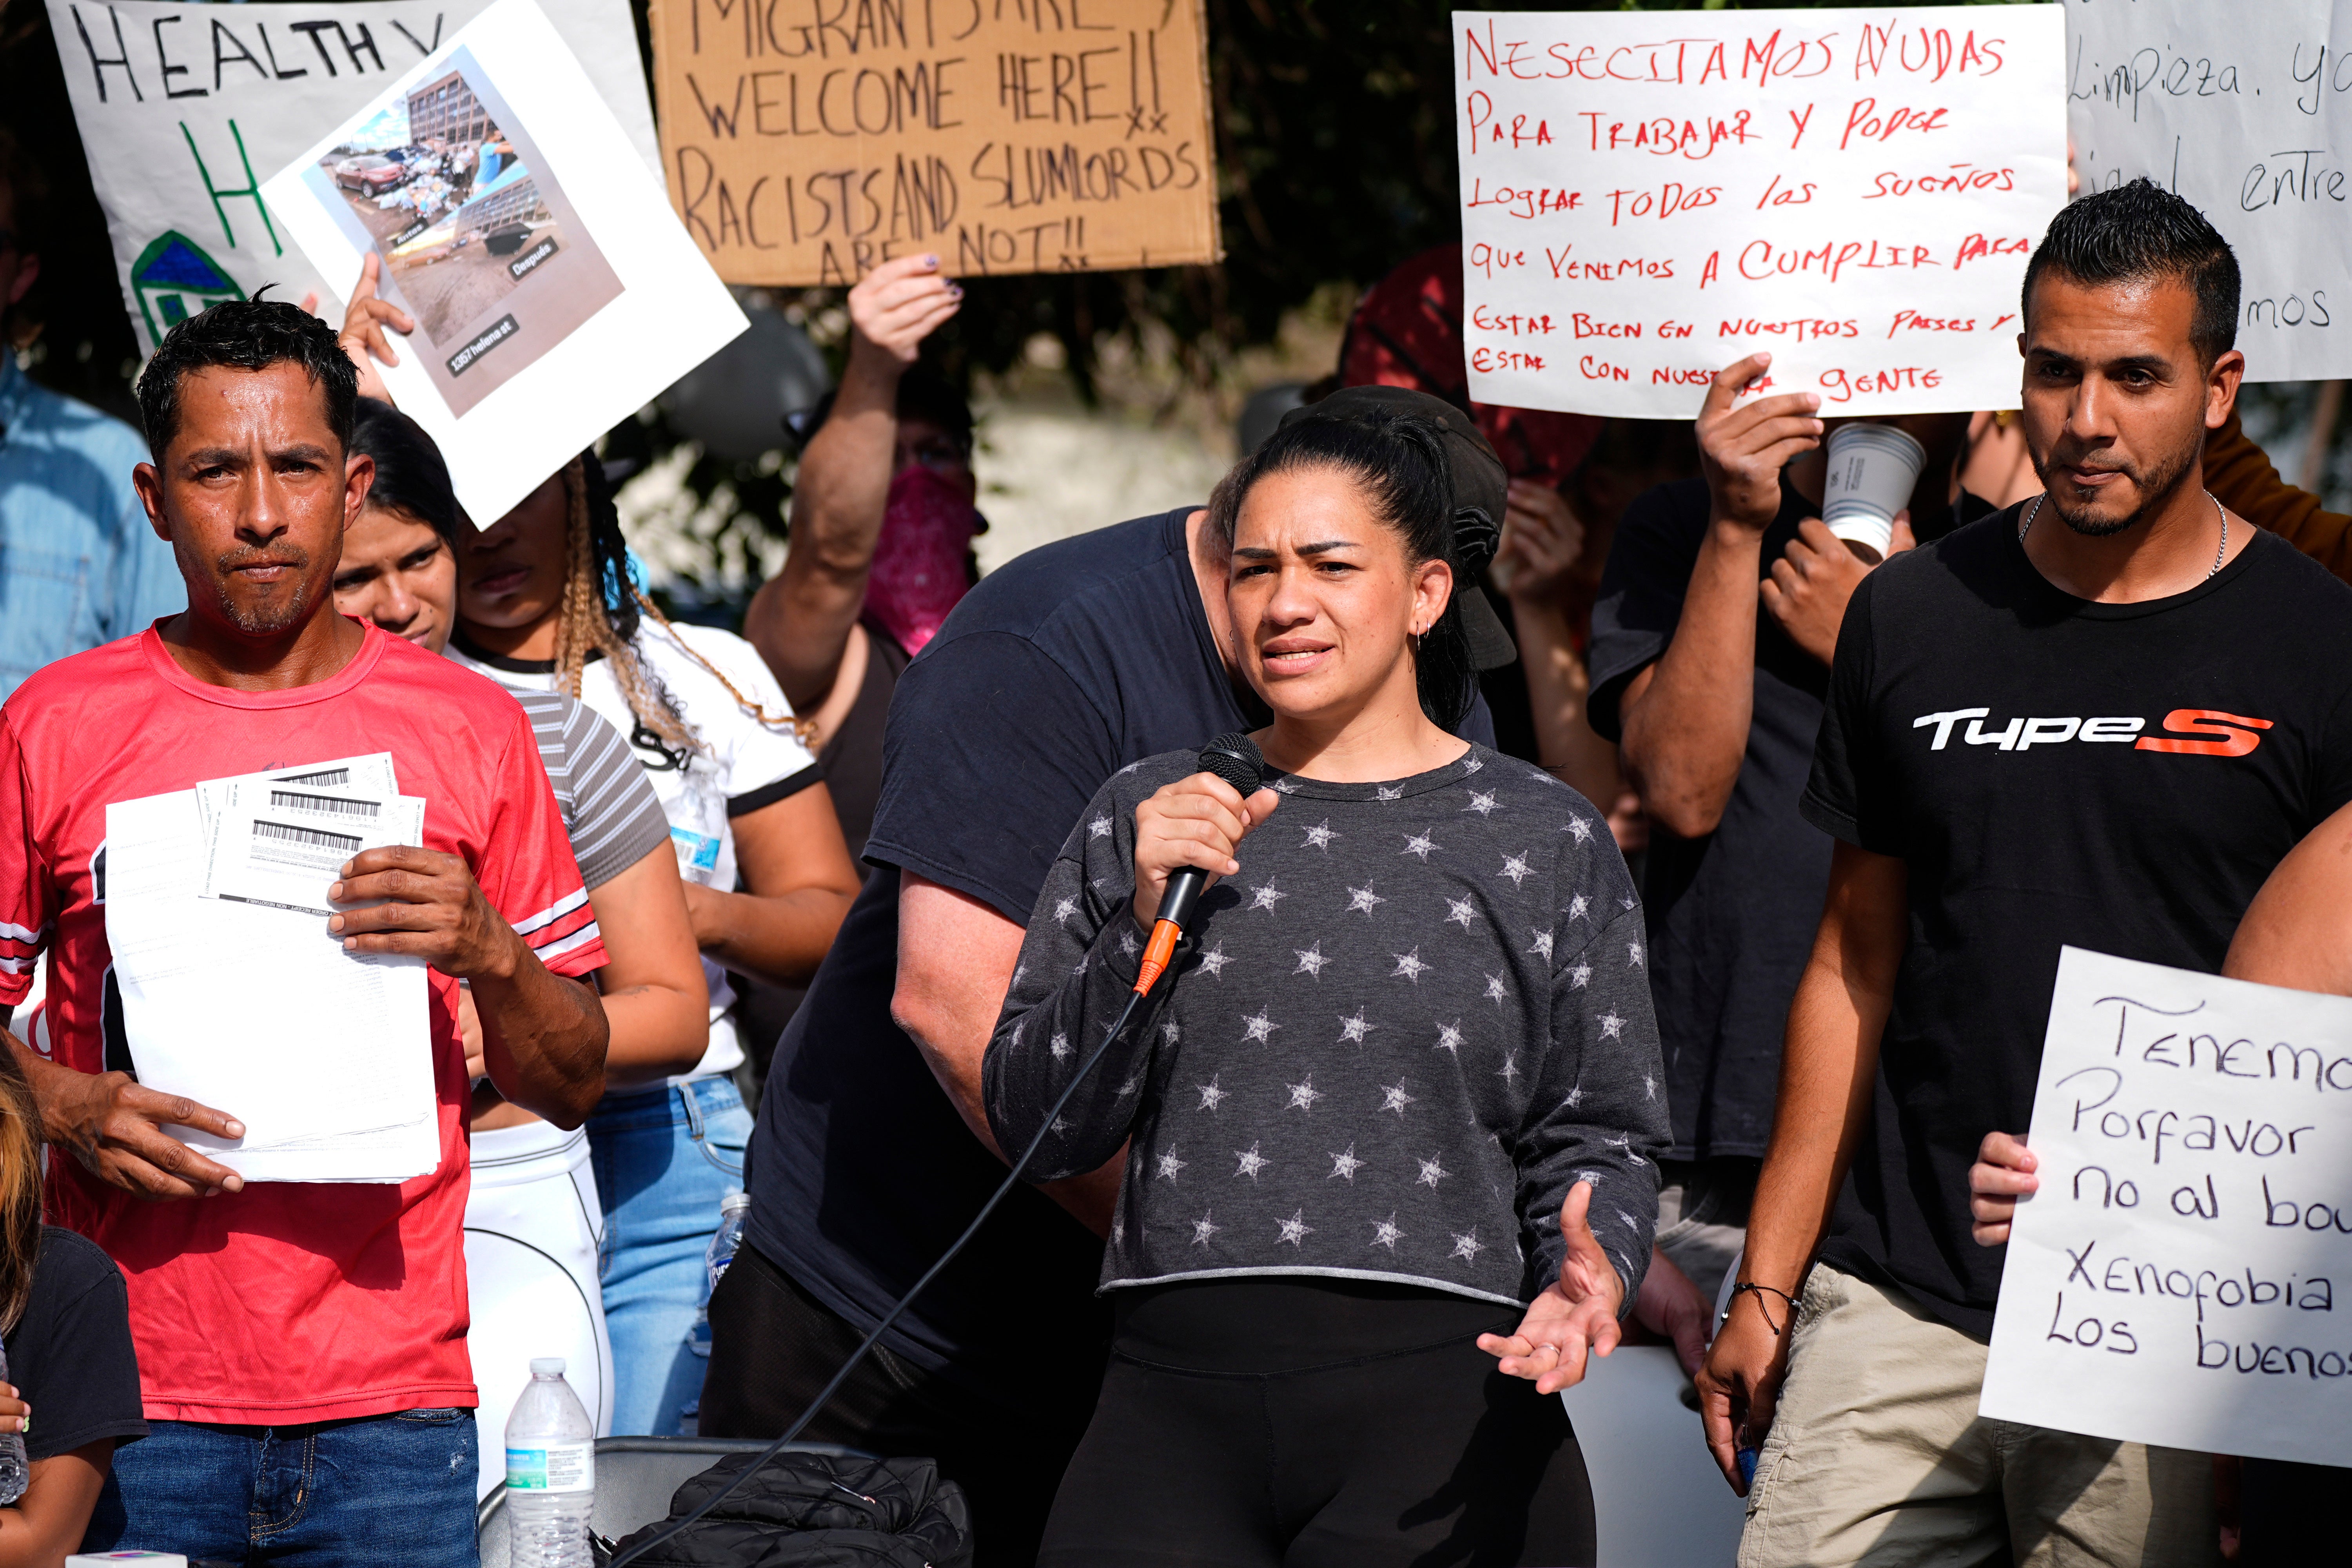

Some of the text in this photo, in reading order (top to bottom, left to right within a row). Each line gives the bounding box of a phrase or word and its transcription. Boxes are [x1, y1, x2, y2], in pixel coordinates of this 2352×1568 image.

[1856, 19, 2005, 83] AYUDAS
[686, 57, 967, 140] WELCOME
[970, 142, 1200, 208] SLUMLORDS
[396, 224, 424, 245] Antes
[512, 243, 552, 276] Después
[1700, 250, 1719, 289] A
[1739, 240, 1939, 282] CUMPLIR
[450, 321, 513, 372] 1357 helena st
[245, 898, 275, 907] NEGOTIABLE
[290, 905, 311, 913] RECEIPT
